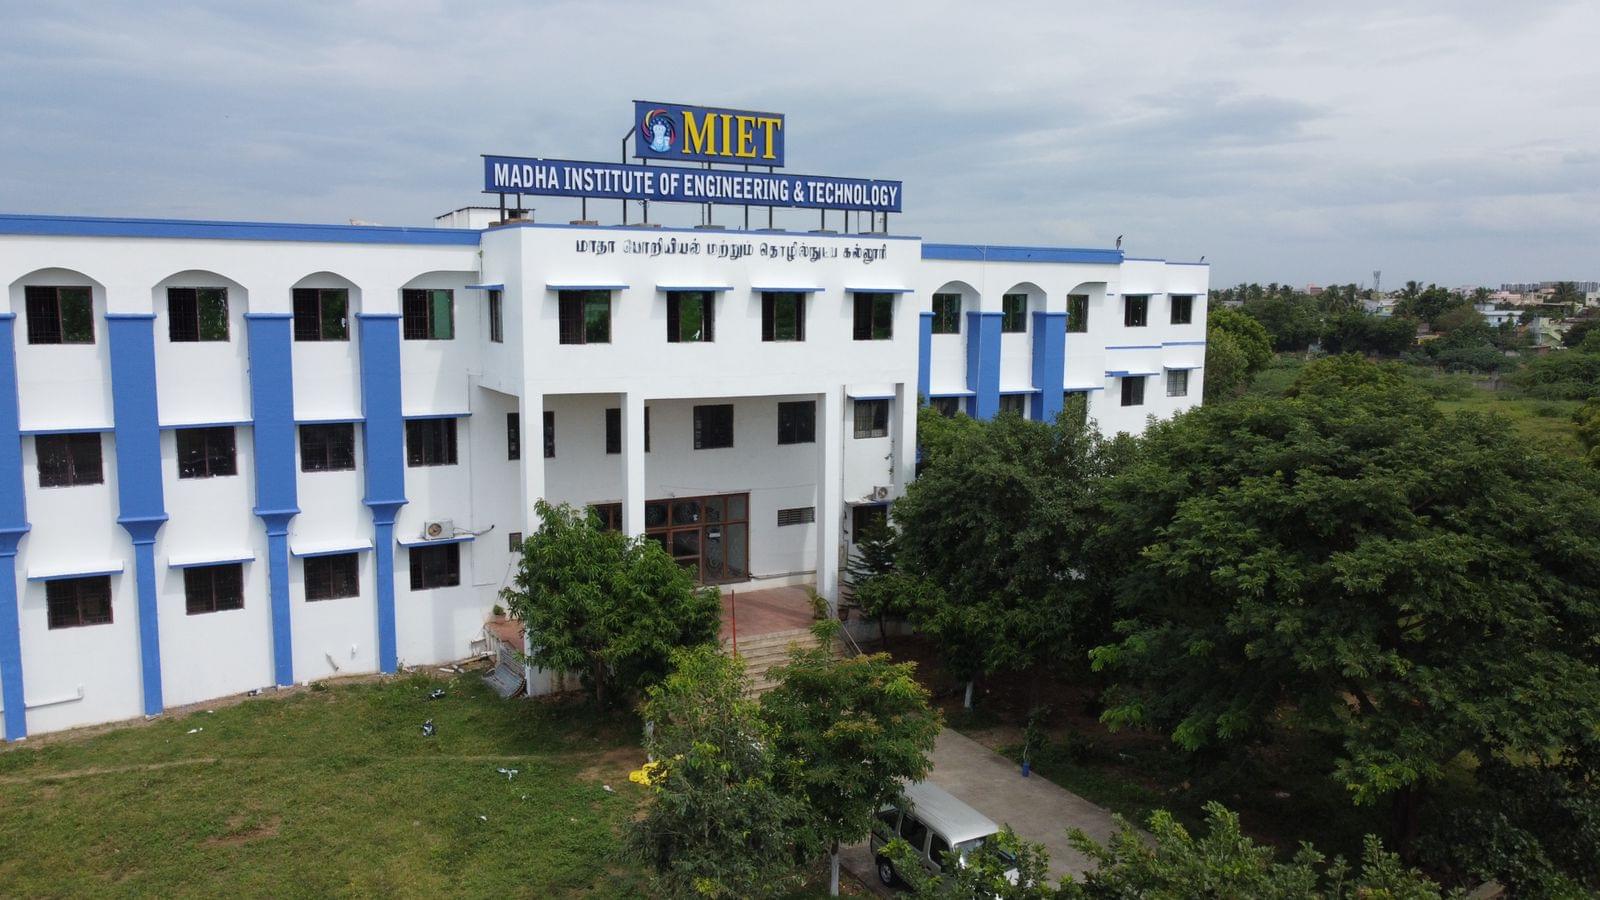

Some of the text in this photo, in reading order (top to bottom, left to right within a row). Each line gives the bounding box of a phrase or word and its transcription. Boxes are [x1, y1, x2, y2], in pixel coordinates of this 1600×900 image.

[682, 111, 782, 159] MIET
[494, 163, 898, 206] MADHA INSTITUTE OF ENGINEERING & TECHNOLOGY
[576, 240, 615, 256] மாதா
